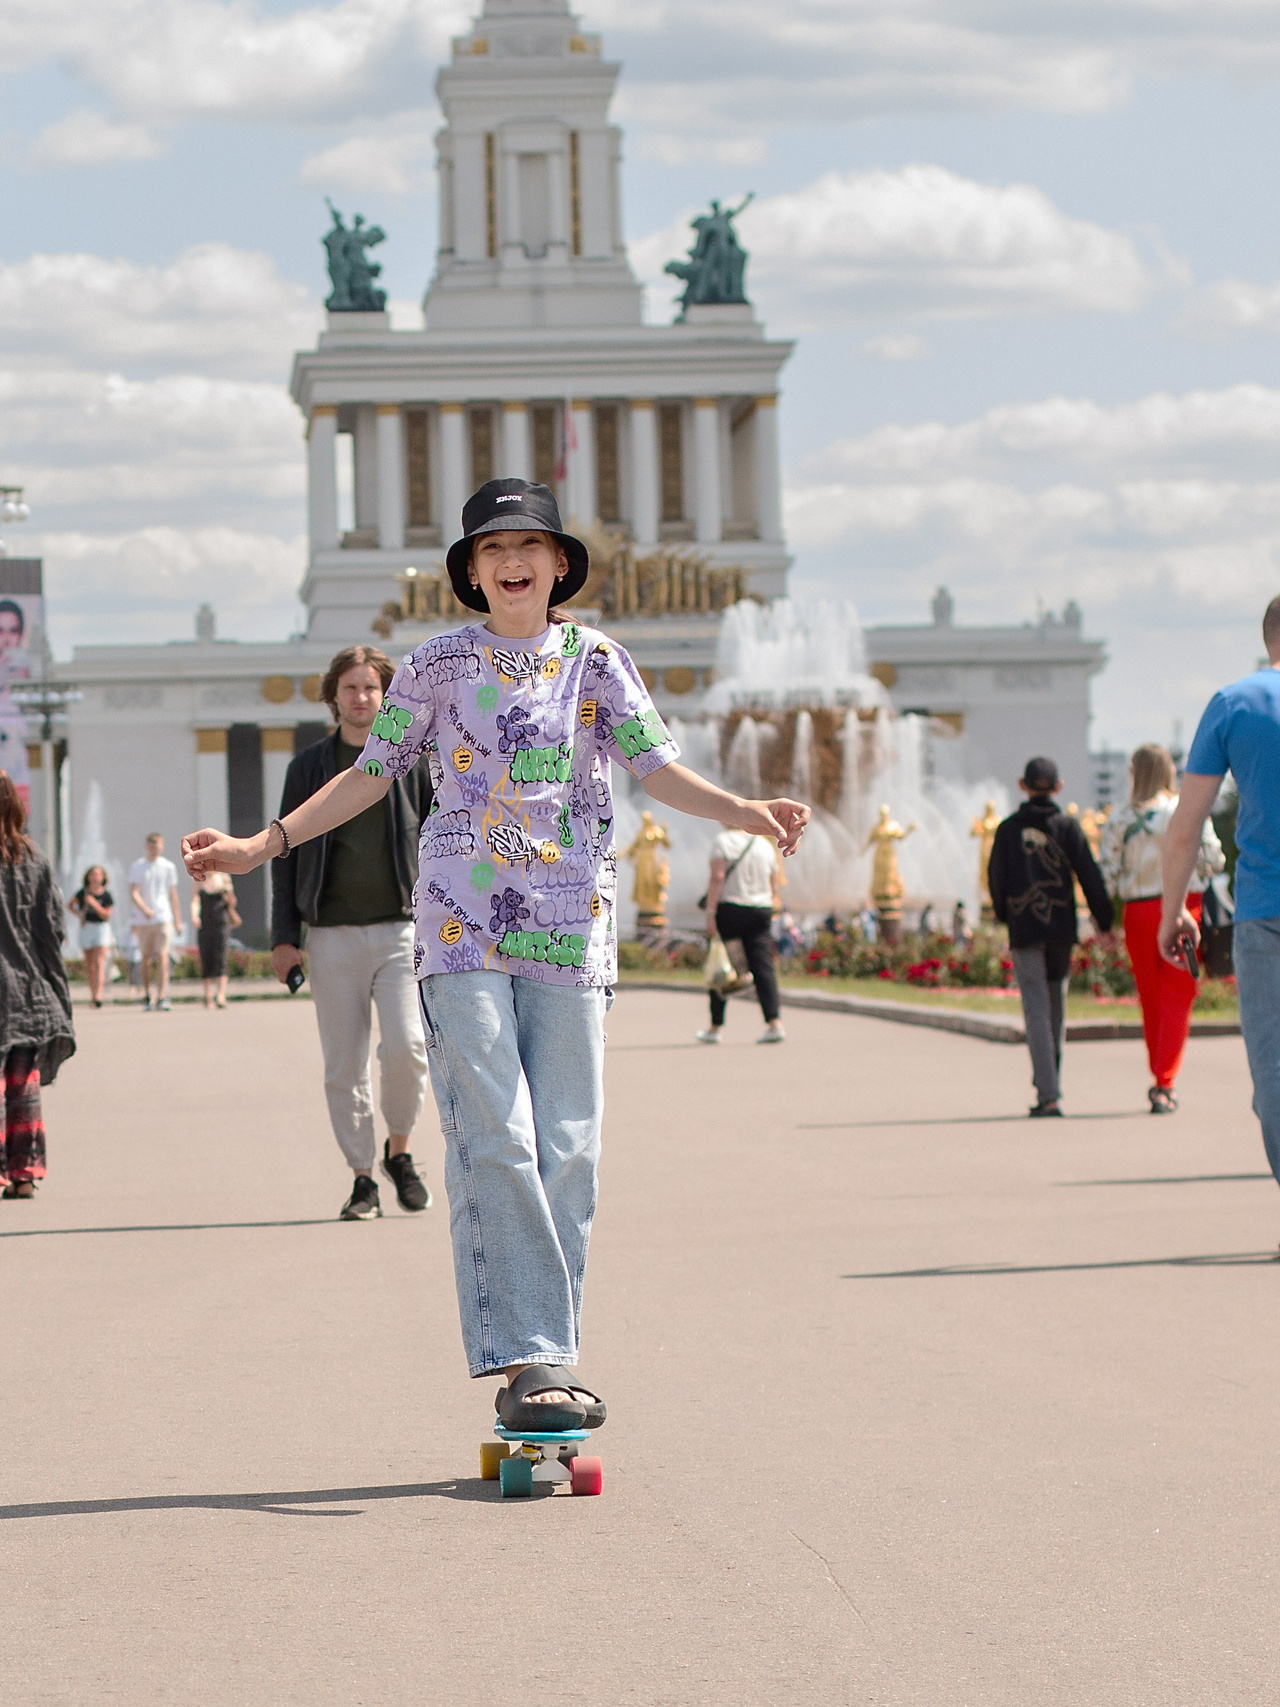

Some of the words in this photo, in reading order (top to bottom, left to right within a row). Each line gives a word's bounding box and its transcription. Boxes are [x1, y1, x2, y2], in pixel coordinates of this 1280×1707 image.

[444, 897, 457, 910] NO
[453, 905, 470, 922] HAS
[466, 918, 484, 934] ART
